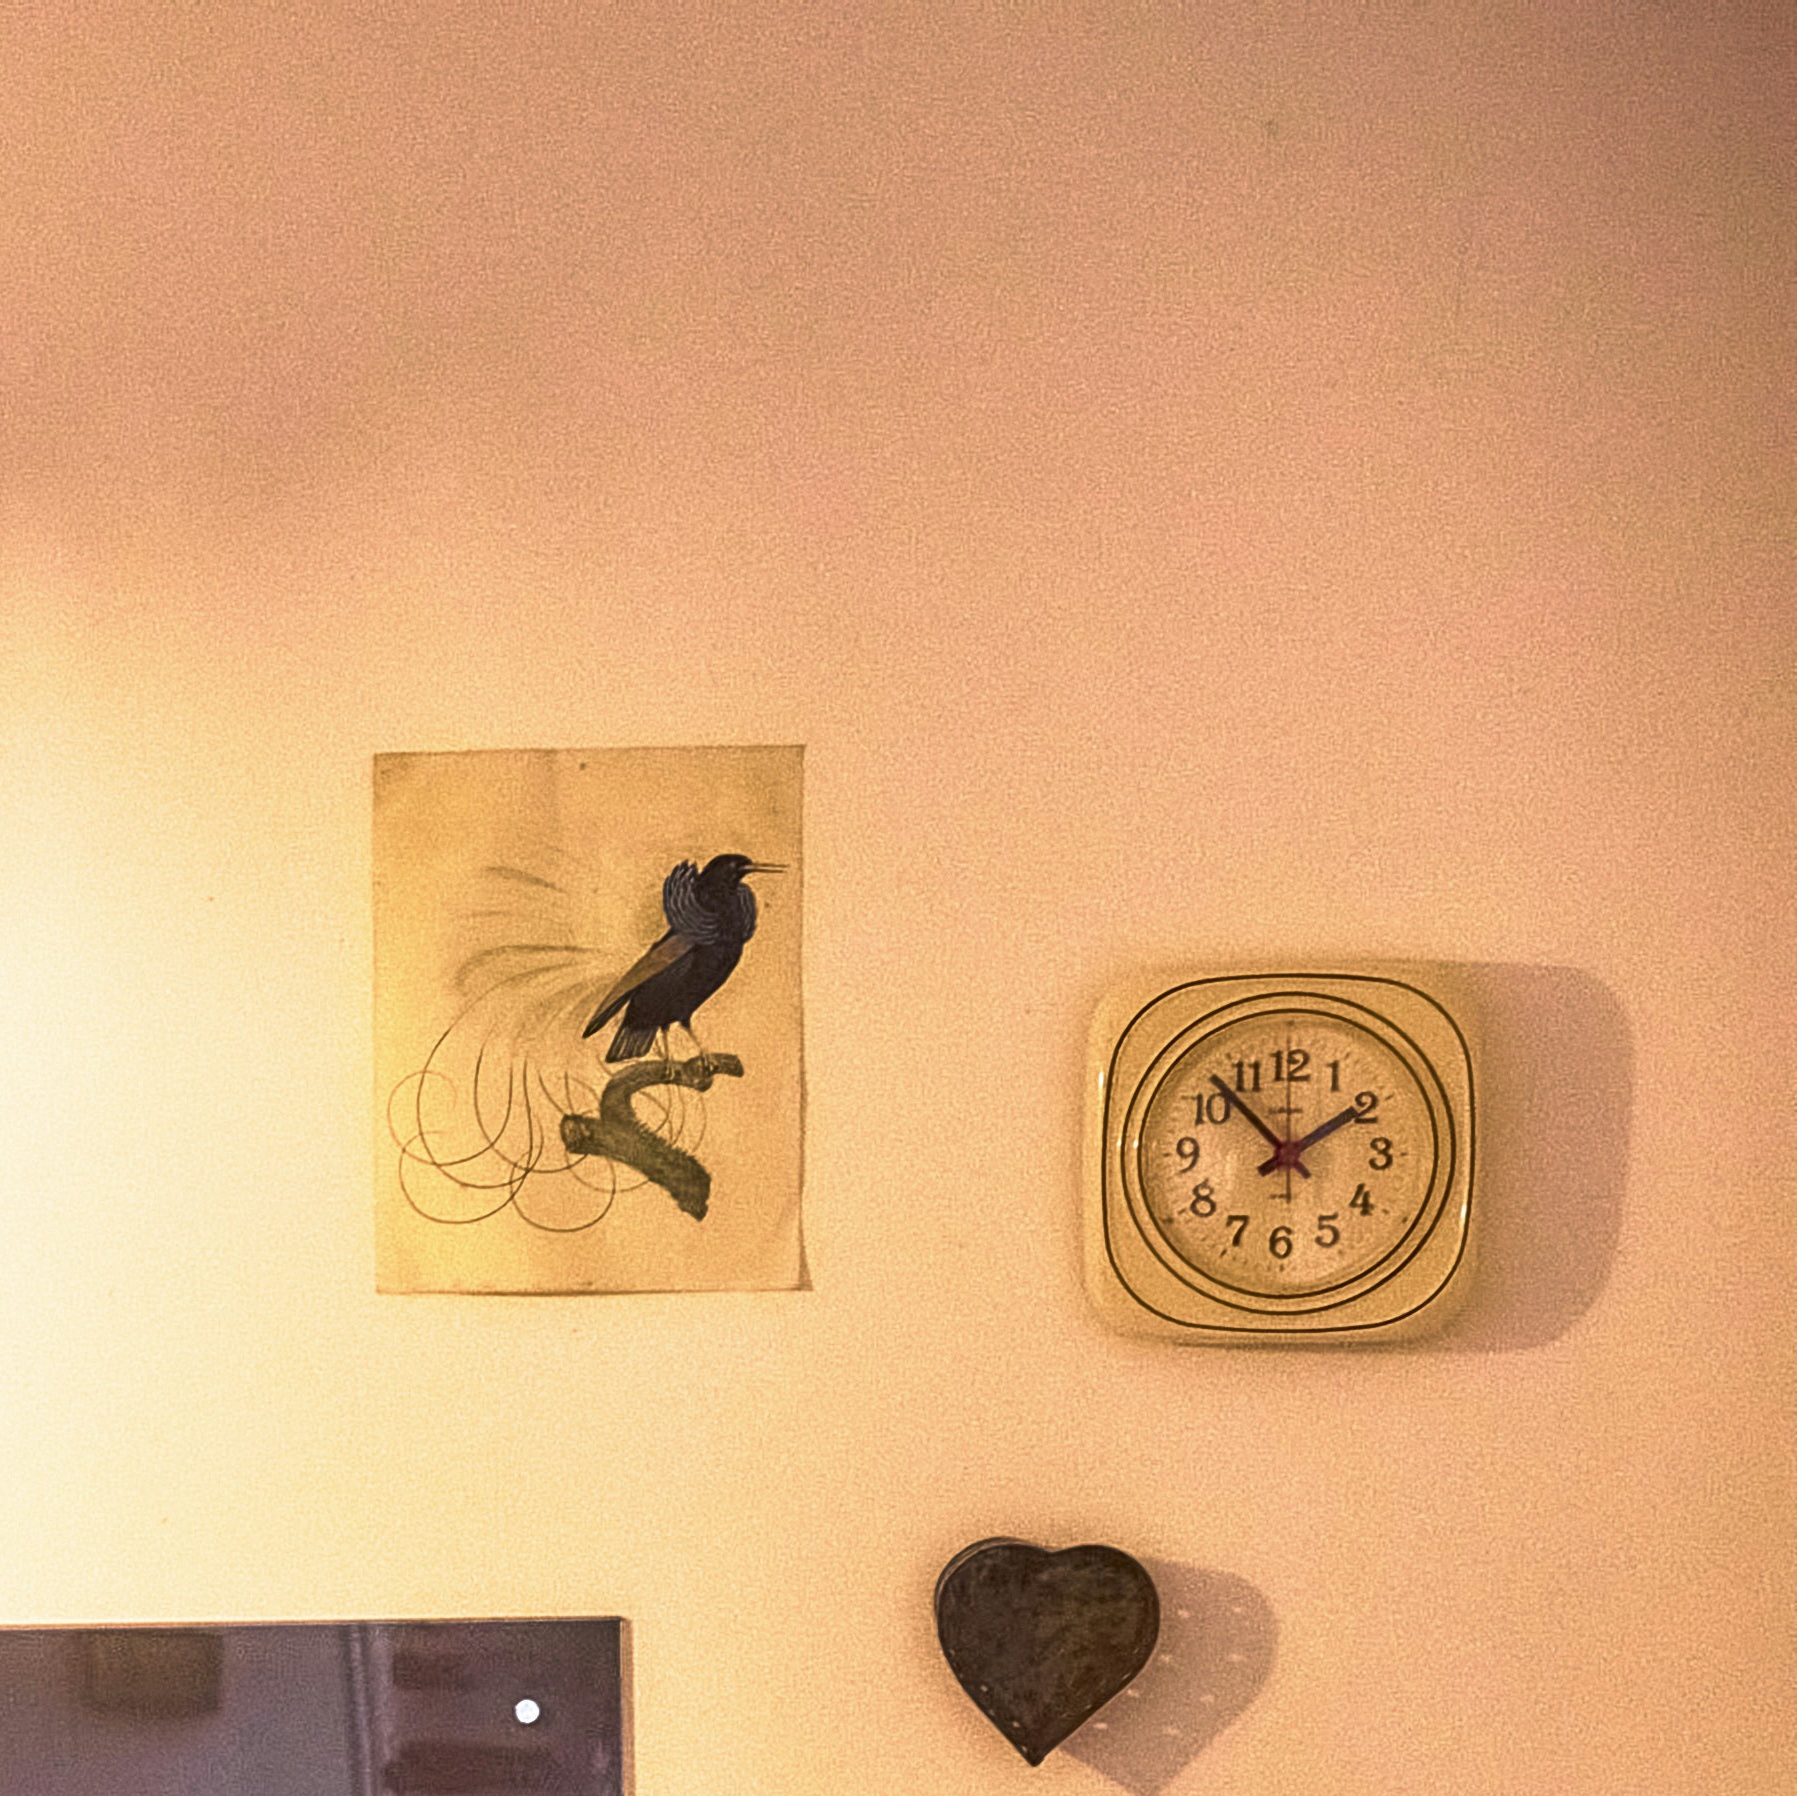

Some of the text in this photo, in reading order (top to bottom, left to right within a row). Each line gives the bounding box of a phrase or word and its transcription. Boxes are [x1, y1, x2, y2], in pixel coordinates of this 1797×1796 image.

[1232, 1061, 1263, 1093] 11
[1270, 1049, 1311, 1083] 12
[1326, 1061, 1341, 1092] 1
[1193, 1093, 1232, 1127] 10
[1354, 1091, 1380, 1125] 2
[1175, 1137, 1200, 1173] 9
[1368, 1137, 1394, 1171] 3
[1190, 1179, 1217, 1217] 8
[1349, 1183, 1375, 1216] 4
[1225, 1215, 1250, 1247] 7
[1269, 1226, 1293, 1259] 6
[1315, 1214, 1341, 1248] 5
